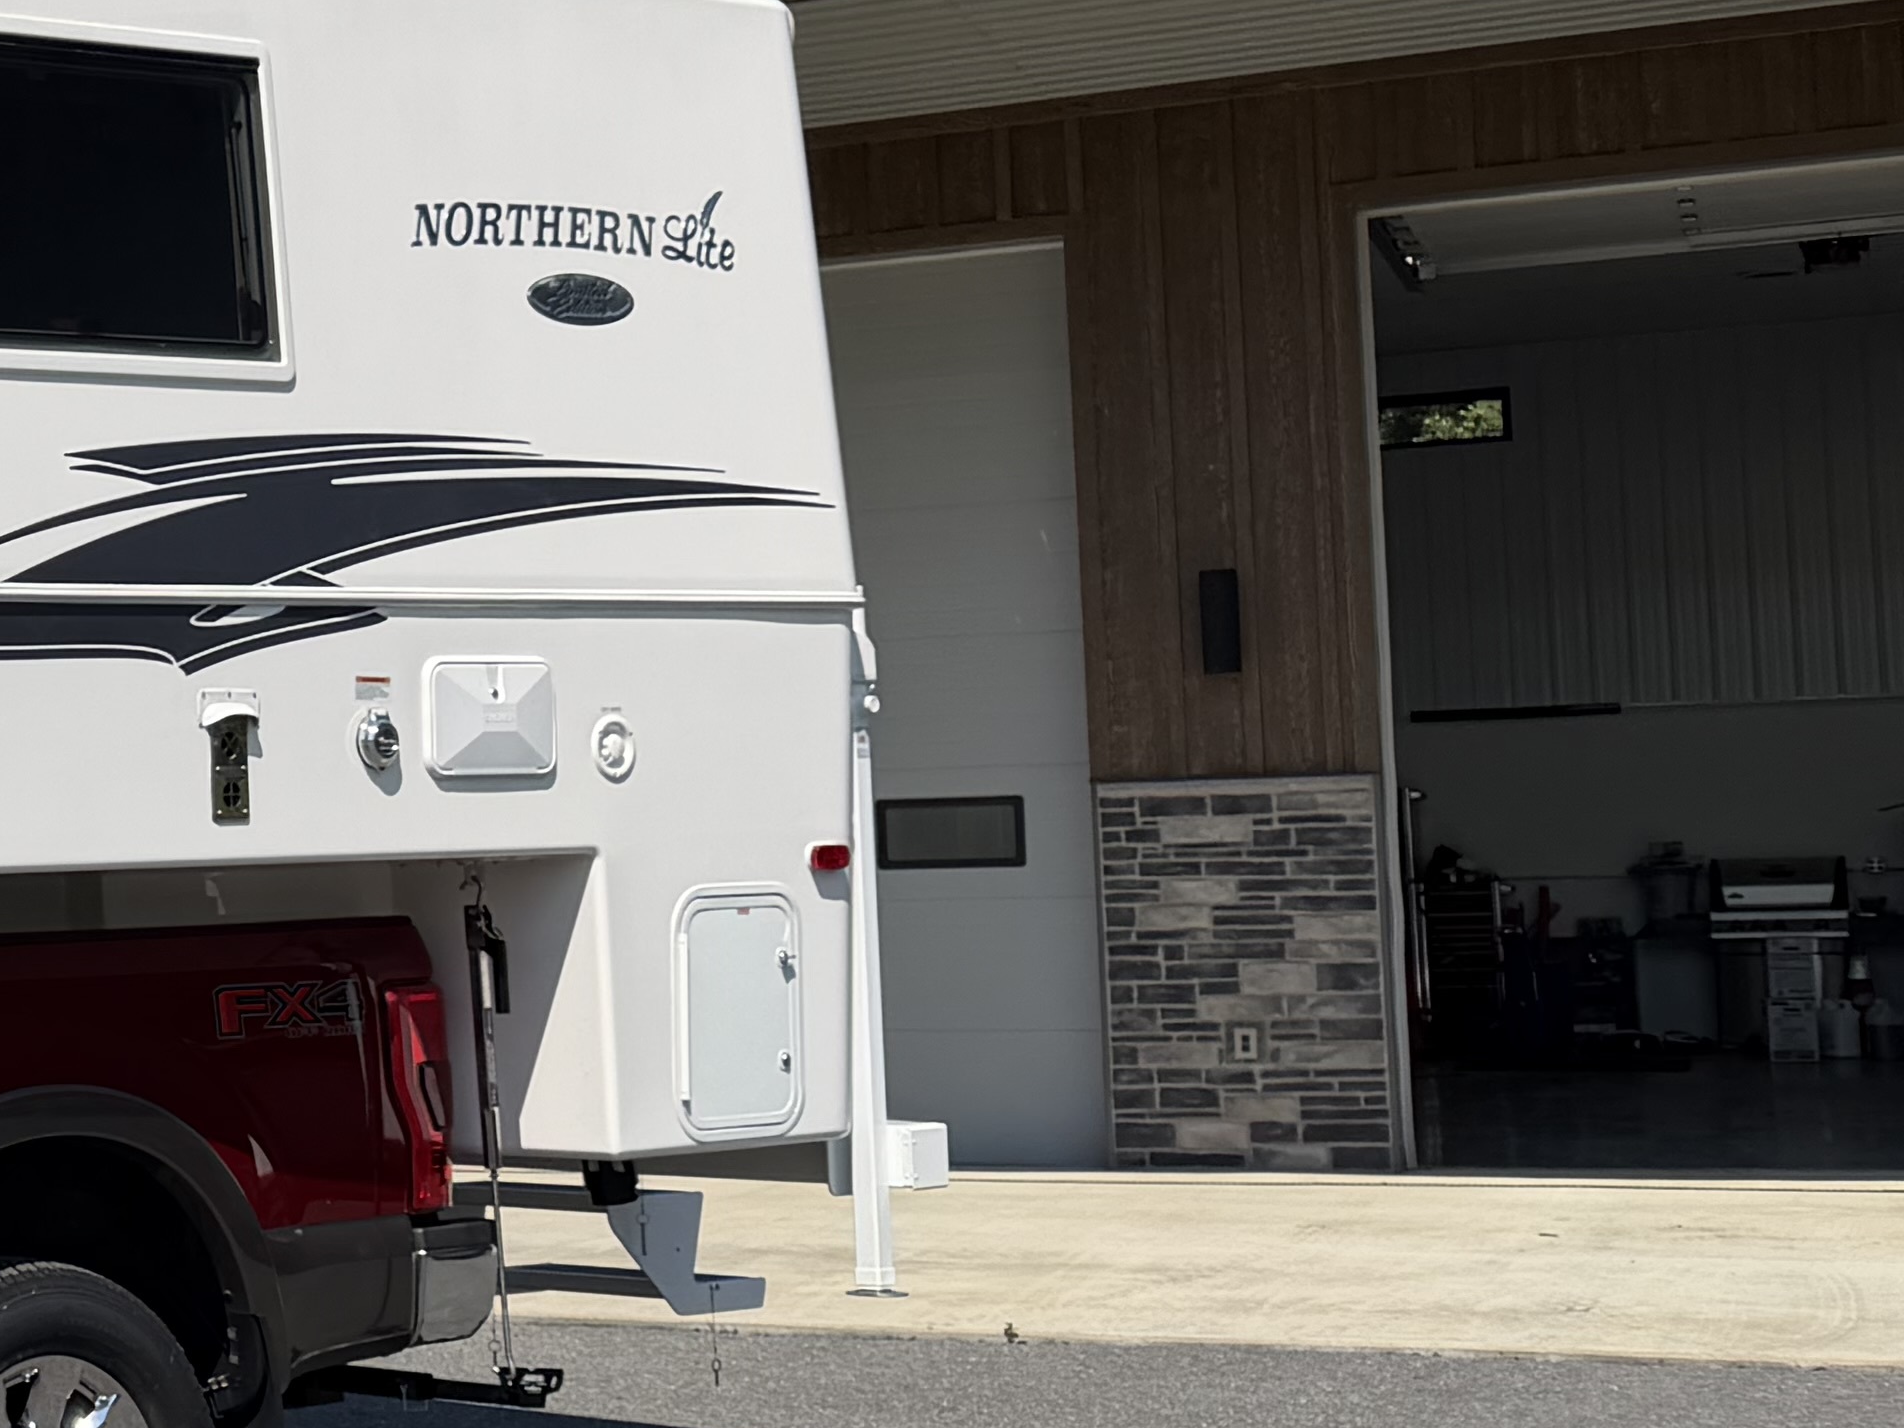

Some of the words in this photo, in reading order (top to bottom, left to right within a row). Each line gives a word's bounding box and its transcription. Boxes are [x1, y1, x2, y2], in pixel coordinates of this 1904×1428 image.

[410, 201, 657, 257] NORTHERN
[660, 190, 736, 272] Lite
[212, 978, 366, 1040] FX4
